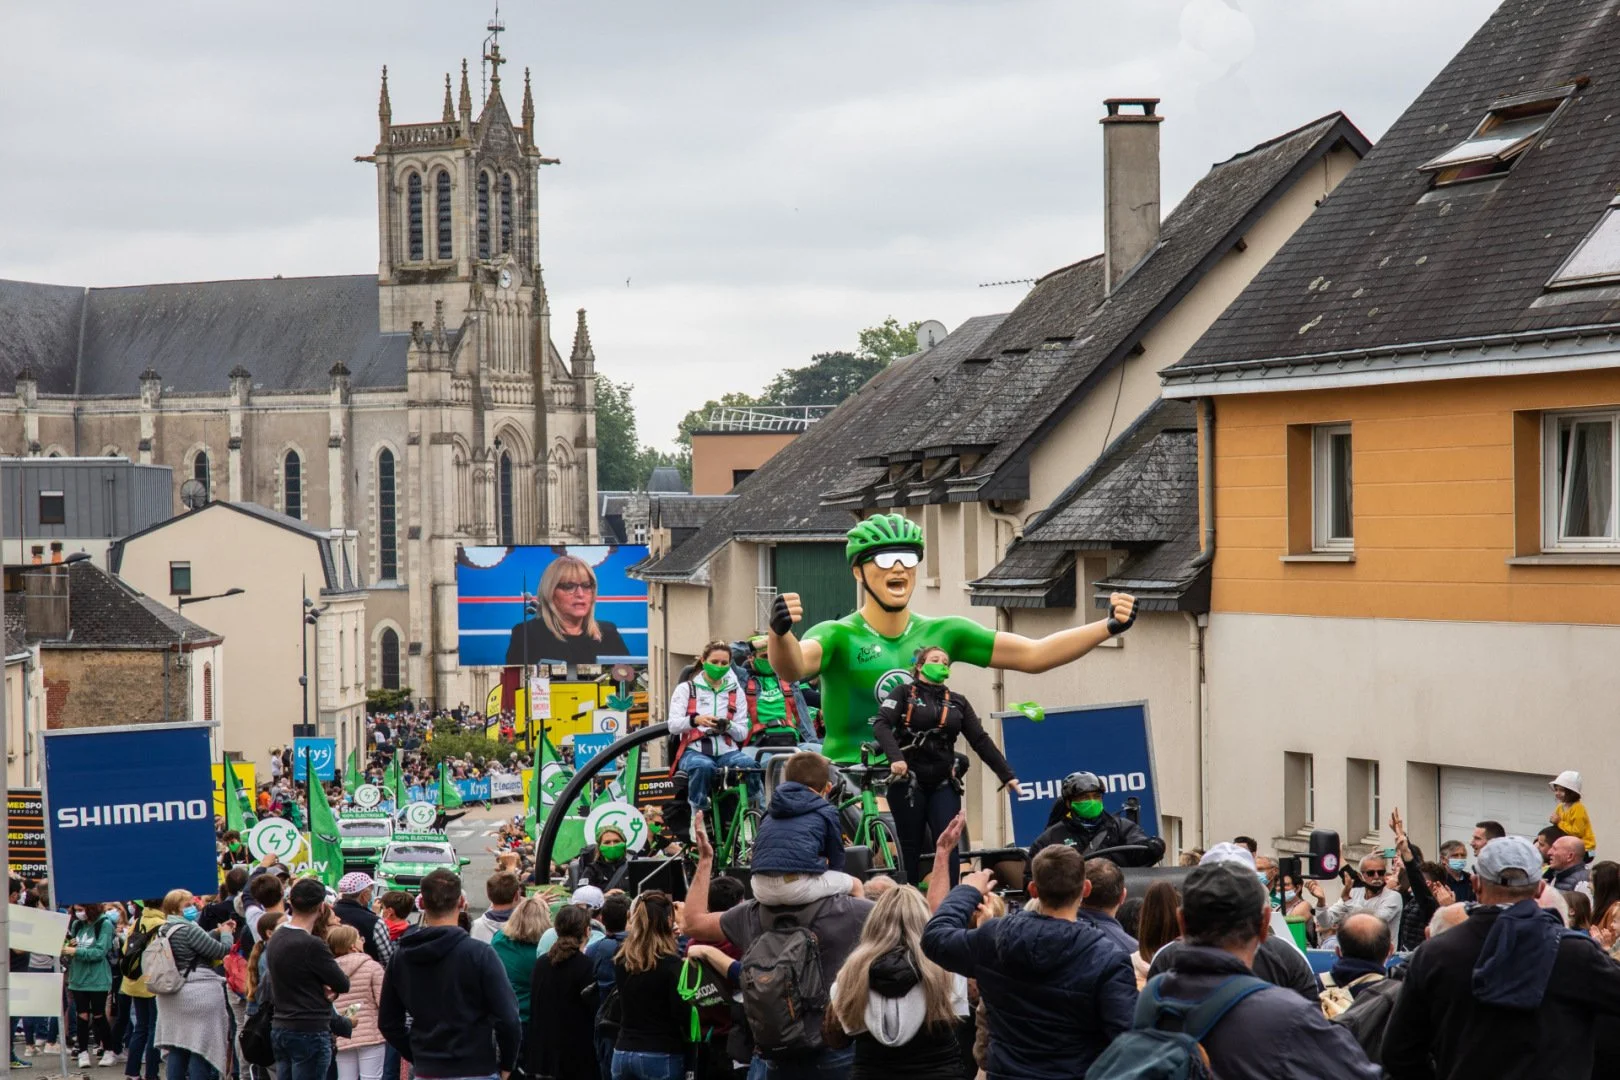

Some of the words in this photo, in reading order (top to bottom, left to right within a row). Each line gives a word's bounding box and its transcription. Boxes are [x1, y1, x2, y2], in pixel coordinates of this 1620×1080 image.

[298, 747, 328, 761] Krys
[470, 782, 488, 797] Krys
[1017, 772, 1146, 801] SHINO
[57, 799, 207, 828] SHIMANO
